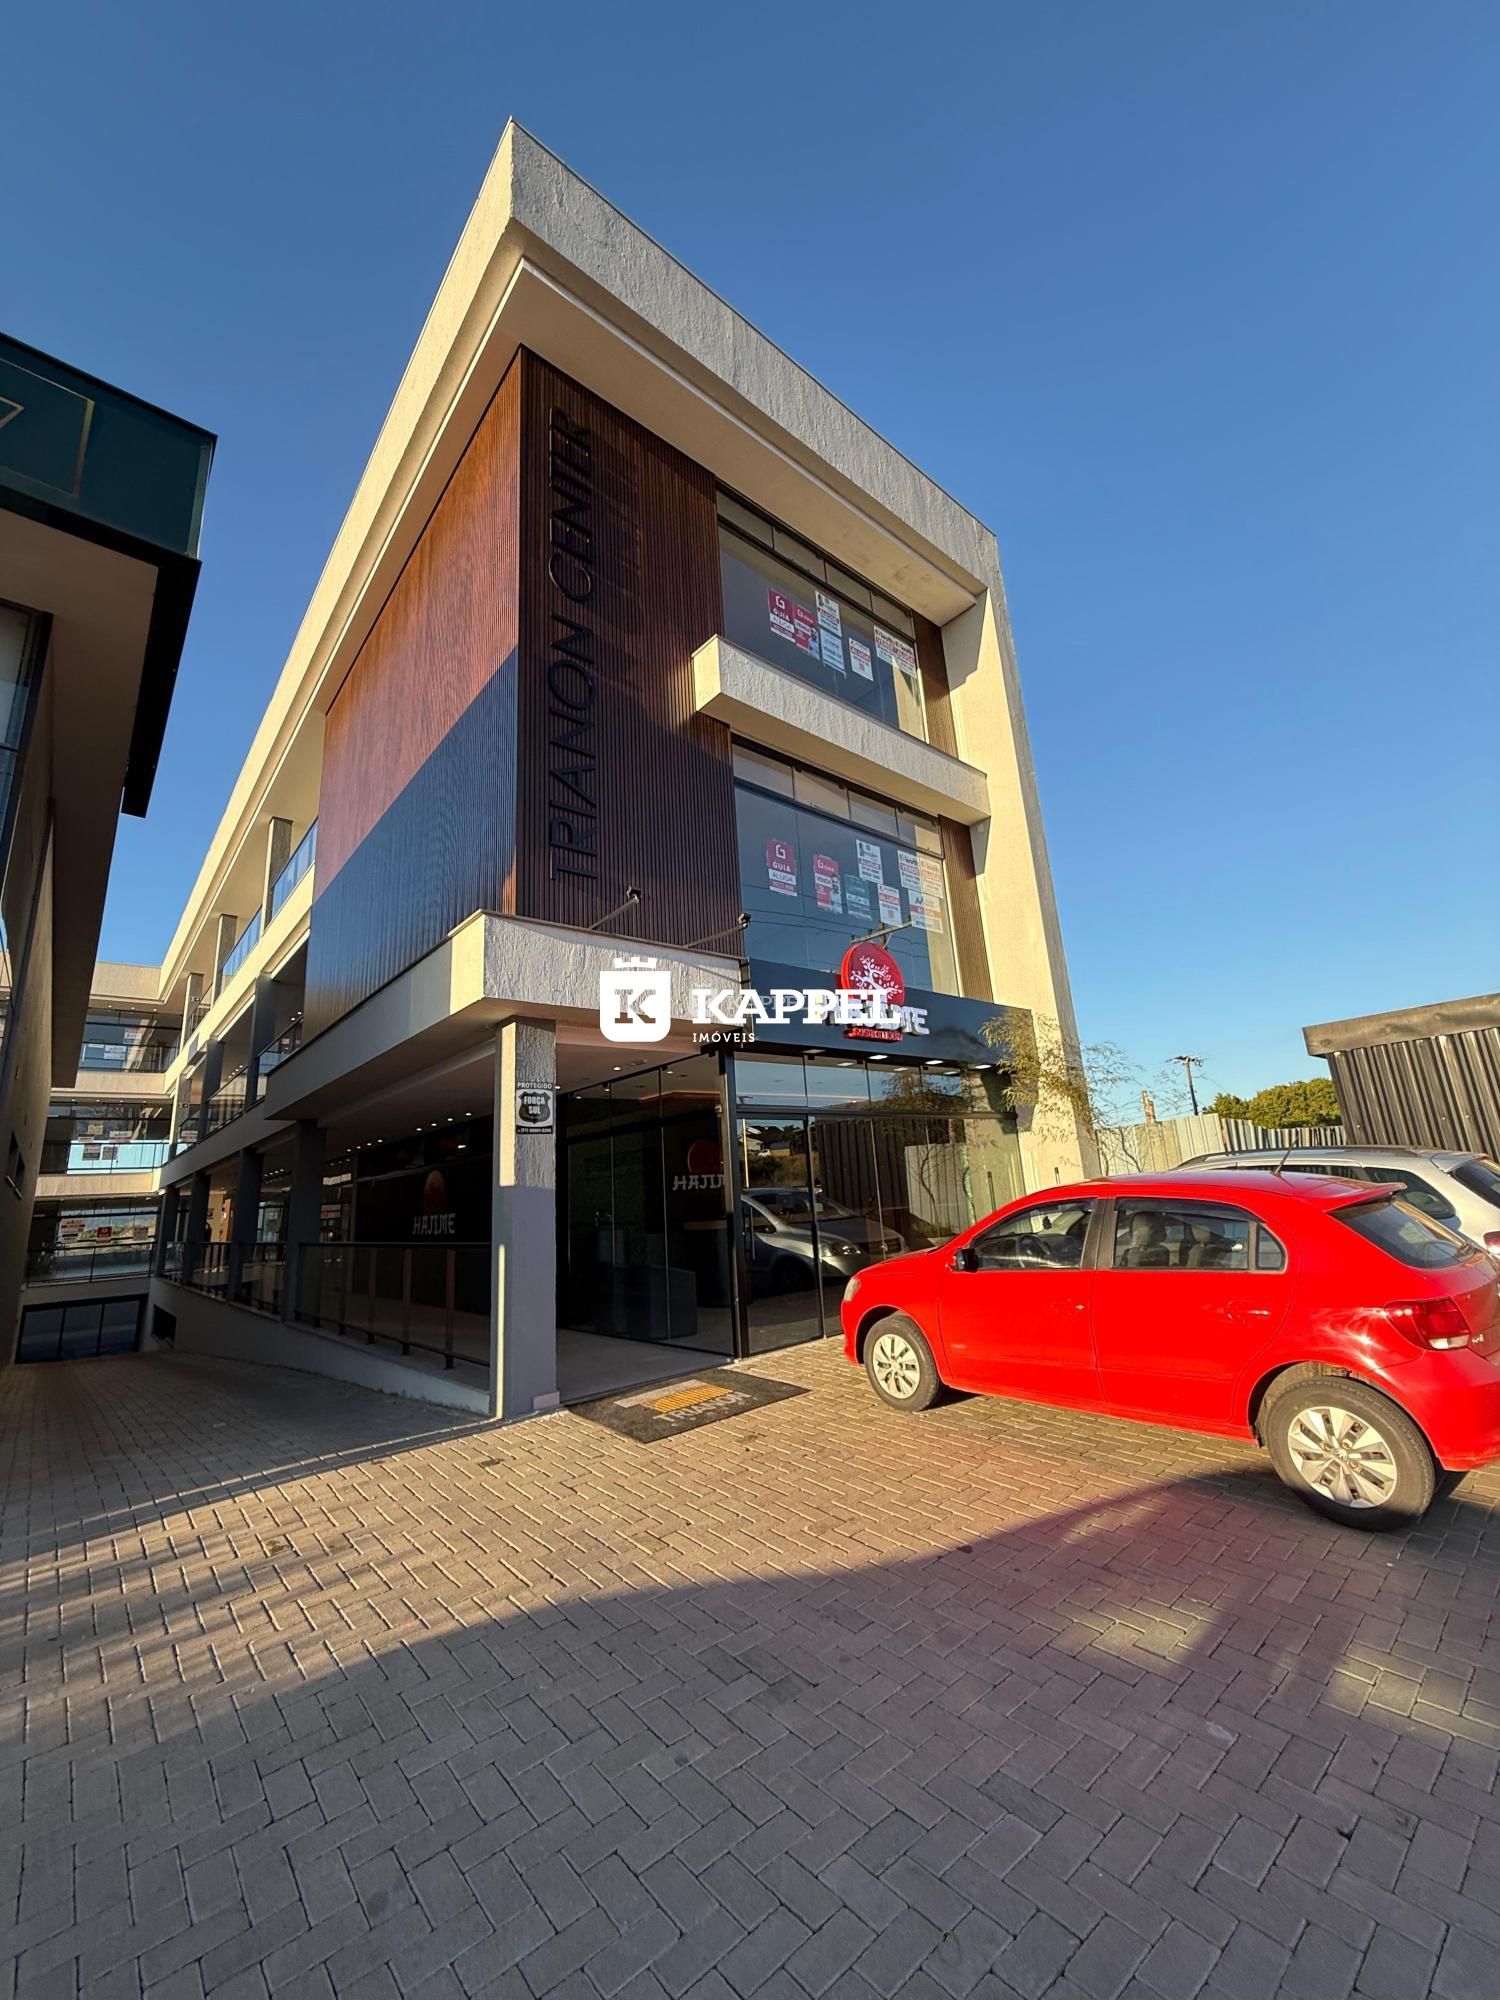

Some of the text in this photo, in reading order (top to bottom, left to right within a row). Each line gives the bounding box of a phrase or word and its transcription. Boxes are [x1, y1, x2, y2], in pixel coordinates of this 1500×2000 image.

[548, 407, 598, 880] TRIANON CENTER
[772, 861, 791, 873] GUIA
[517, 1081, 552, 1089] PROTEGIDO
[523, 1096, 545, 1106] FORÇA
[528, 1106, 541, 1115] SUL
[412, 1213, 456, 1235] HAJIME
[653, 1391, 752, 1422] TRIANON
